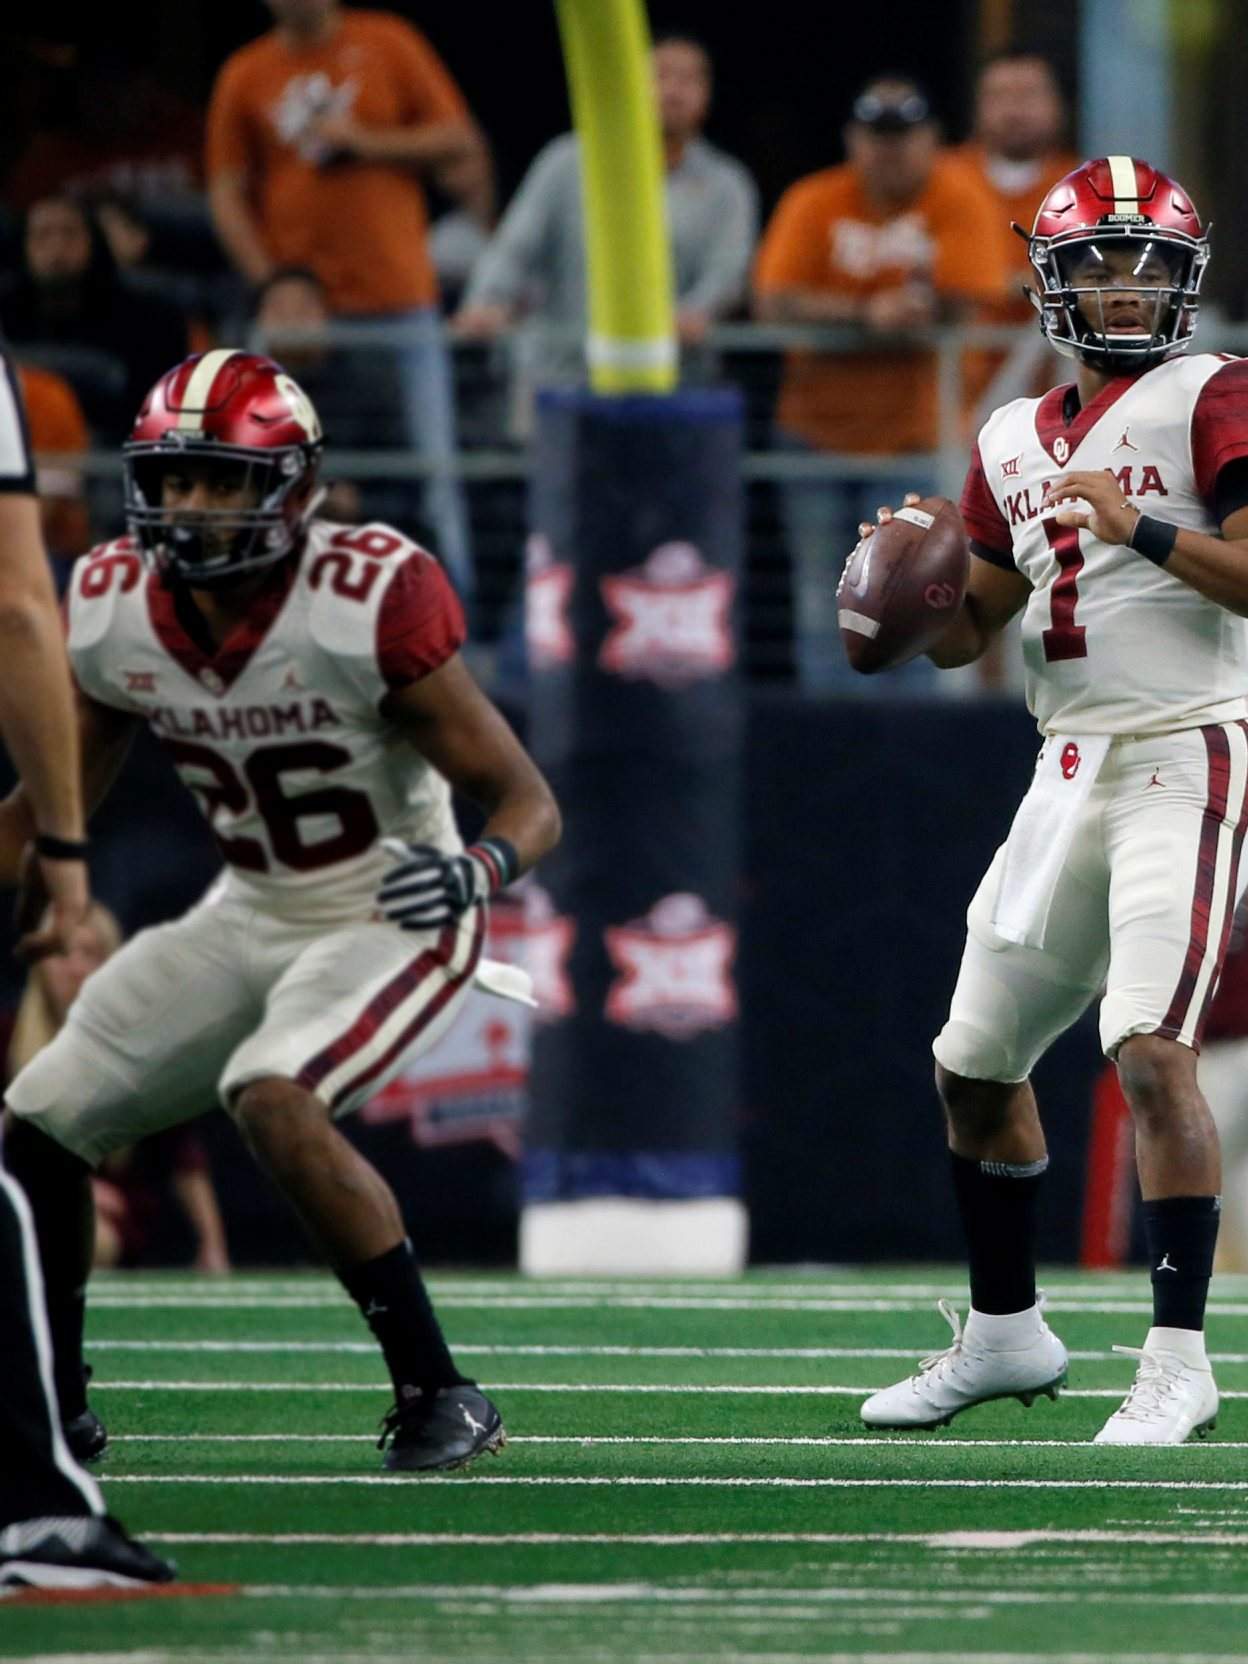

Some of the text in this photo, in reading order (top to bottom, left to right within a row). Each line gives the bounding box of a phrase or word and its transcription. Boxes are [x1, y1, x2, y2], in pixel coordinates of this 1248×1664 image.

[308, 530, 403, 605] 26
[145, 697, 343, 739] KLAHOMA
[160, 738, 380, 874] 26
